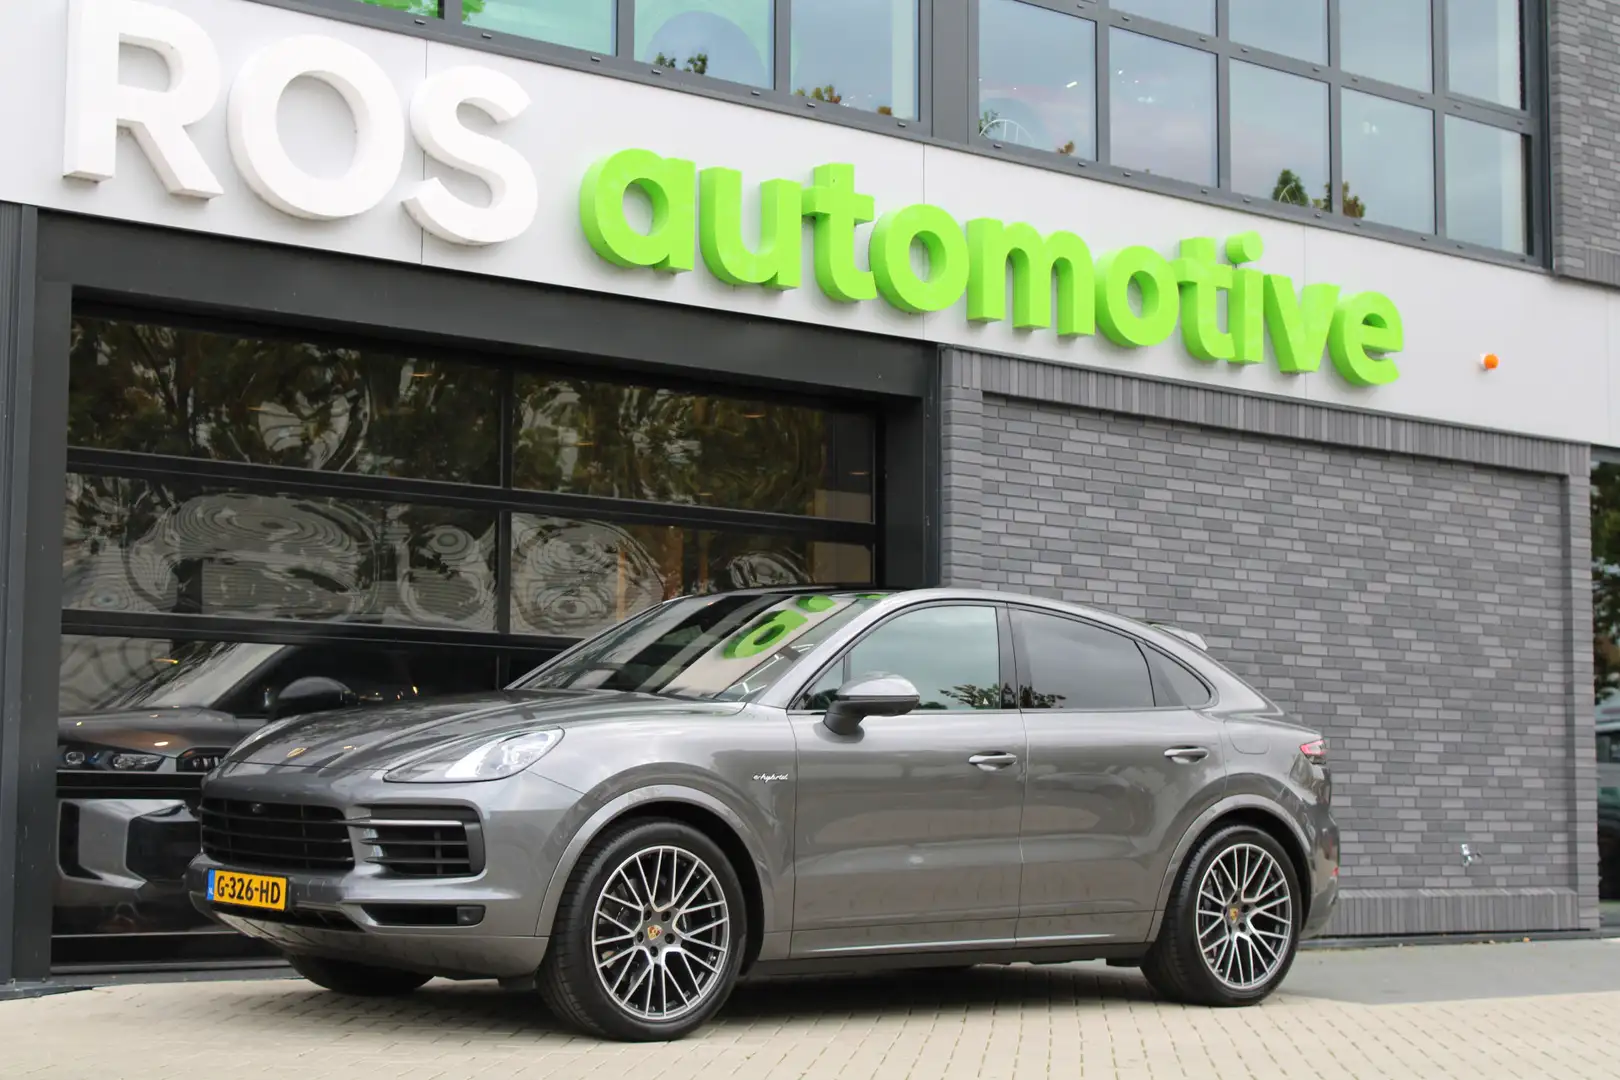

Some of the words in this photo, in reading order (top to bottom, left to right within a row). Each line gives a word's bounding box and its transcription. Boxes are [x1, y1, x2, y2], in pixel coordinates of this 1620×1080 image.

[63, 0, 539, 247] ROS
[579, 147, 1404, 387] automotive
[217, 875, 281, 904] G-326-HD
